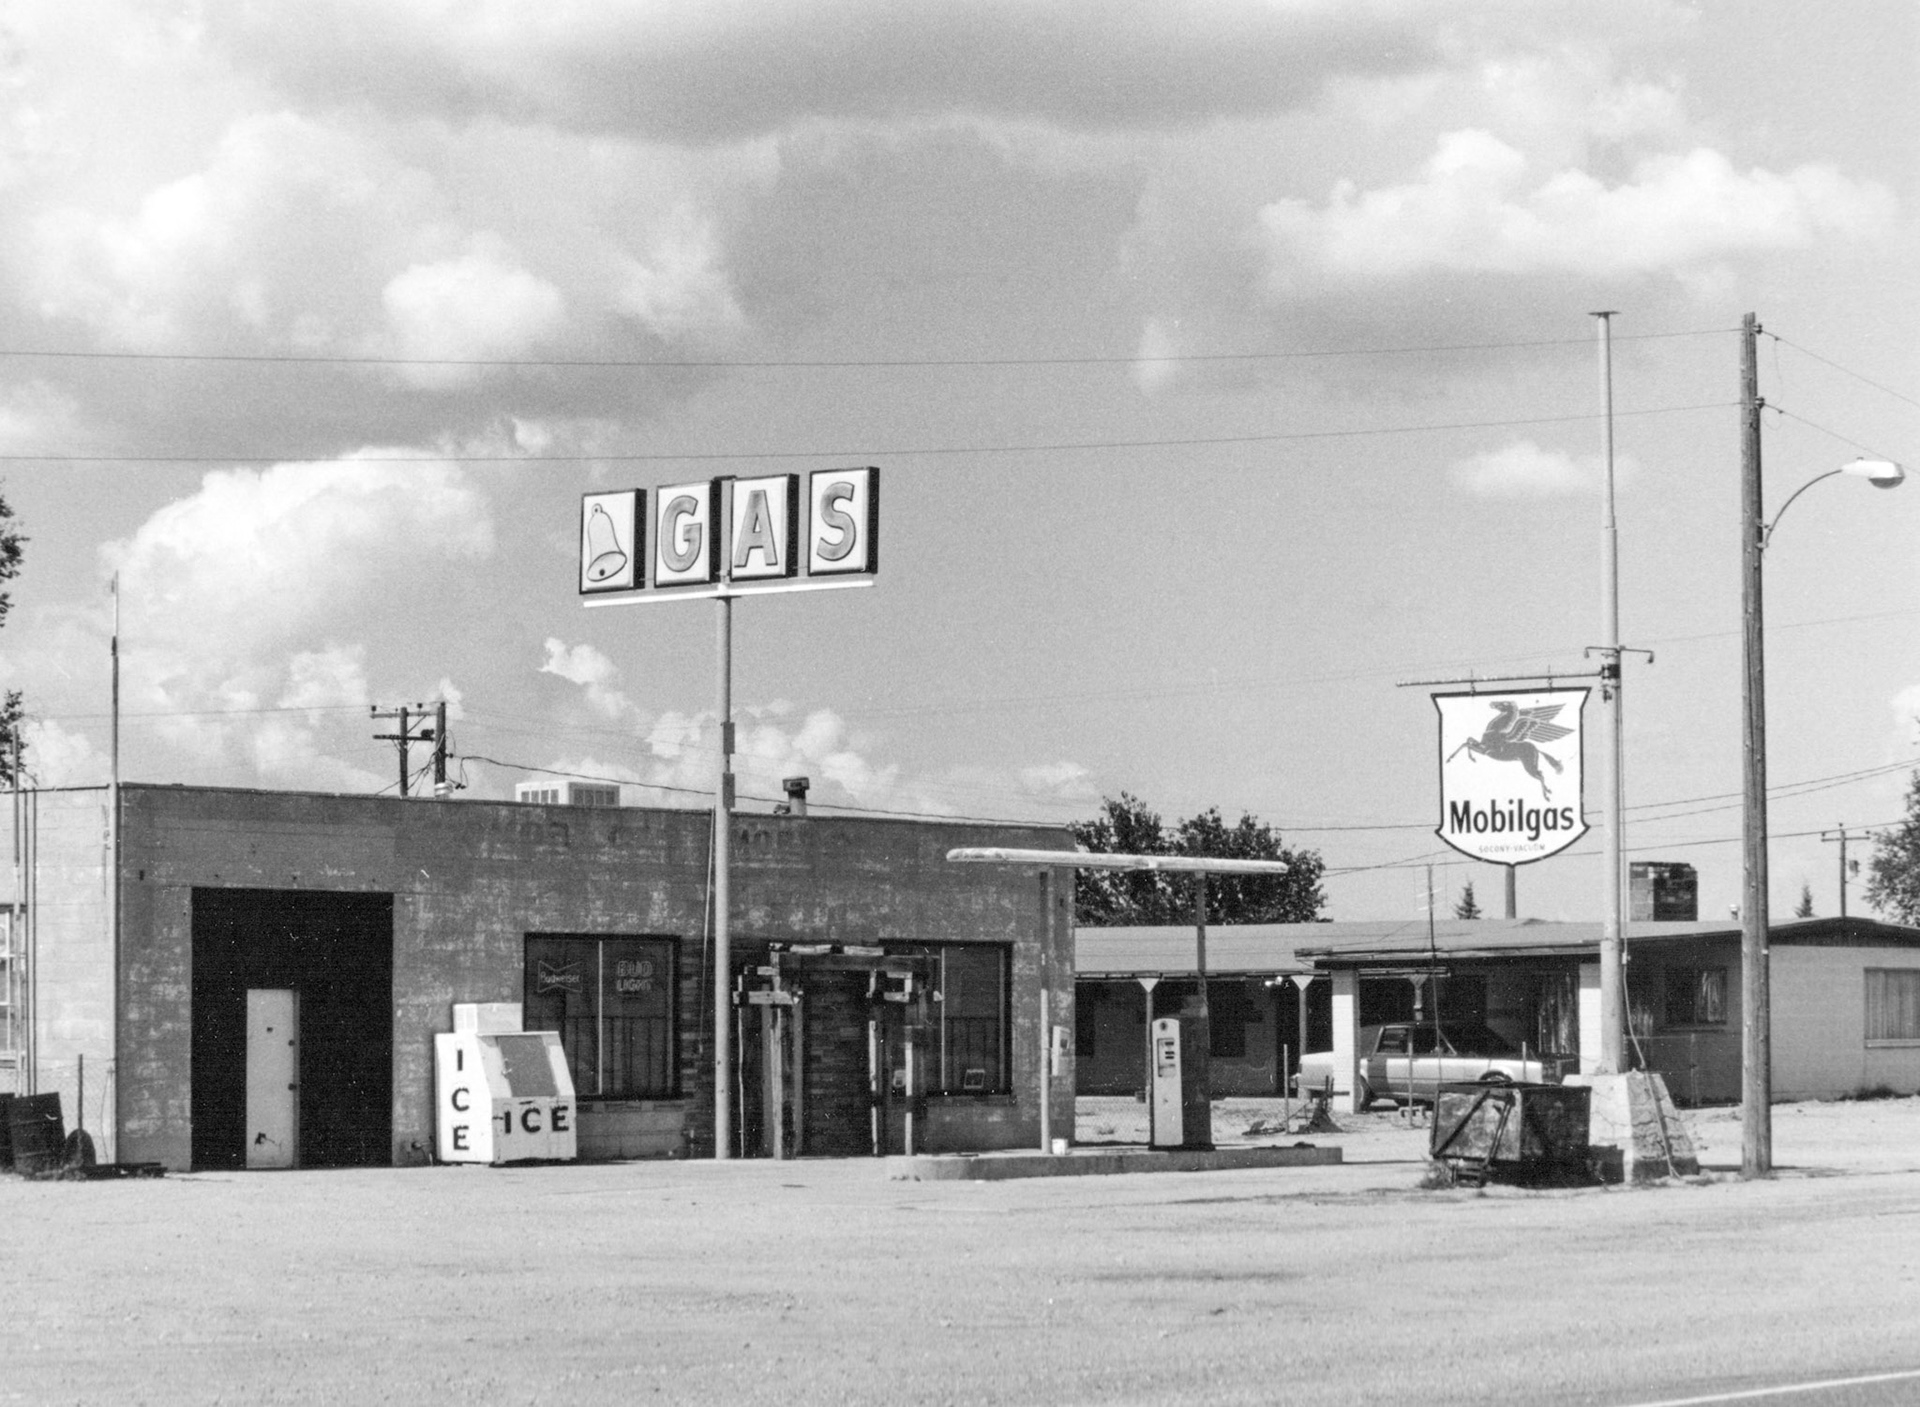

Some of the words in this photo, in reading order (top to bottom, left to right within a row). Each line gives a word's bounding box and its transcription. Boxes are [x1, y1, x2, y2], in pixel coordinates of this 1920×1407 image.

[661, 481, 857, 573] GAS
[1450, 798, 1575, 841] Mobilgas
[616, 978, 653, 992] LIGHT
[617, 960, 653, 977] BUD
[451, 1048, 470, 1150] ICE
[504, 1104, 570, 1135] ICE
